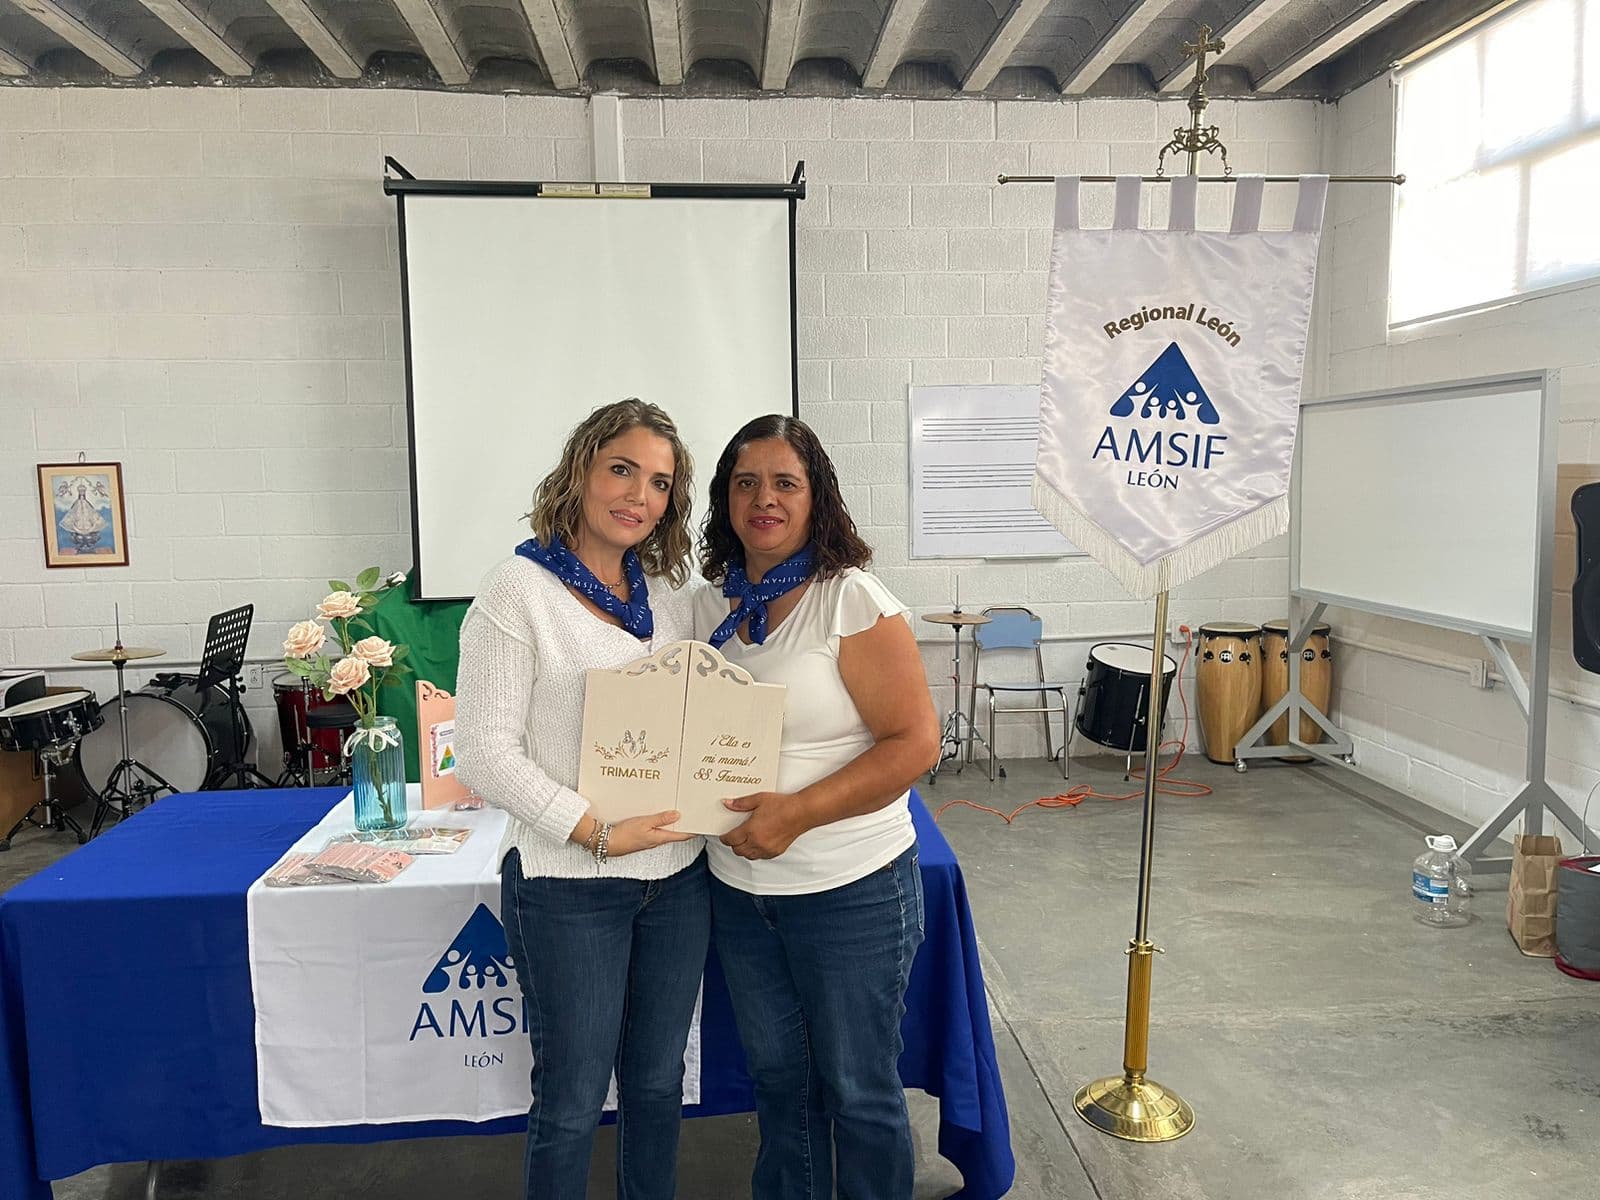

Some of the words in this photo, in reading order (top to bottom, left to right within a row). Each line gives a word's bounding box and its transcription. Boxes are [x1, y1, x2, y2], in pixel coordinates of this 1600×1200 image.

[1103, 303, 1195, 339] Regional
[1196, 307, 1241, 347] León
[1092, 426, 1228, 469] AMSIF
[1127, 468, 1179, 489] LEÓN
[741, 741, 752, 749] es
[701, 753, 716, 764] mi
[718, 755, 757, 767] mamá!
[600, 765, 661, 780] TRIMATER
[715, 769, 762, 785] Francisco
[409, 997, 530, 1041] AMSI
[464, 1051, 504, 1068] LEÓN
